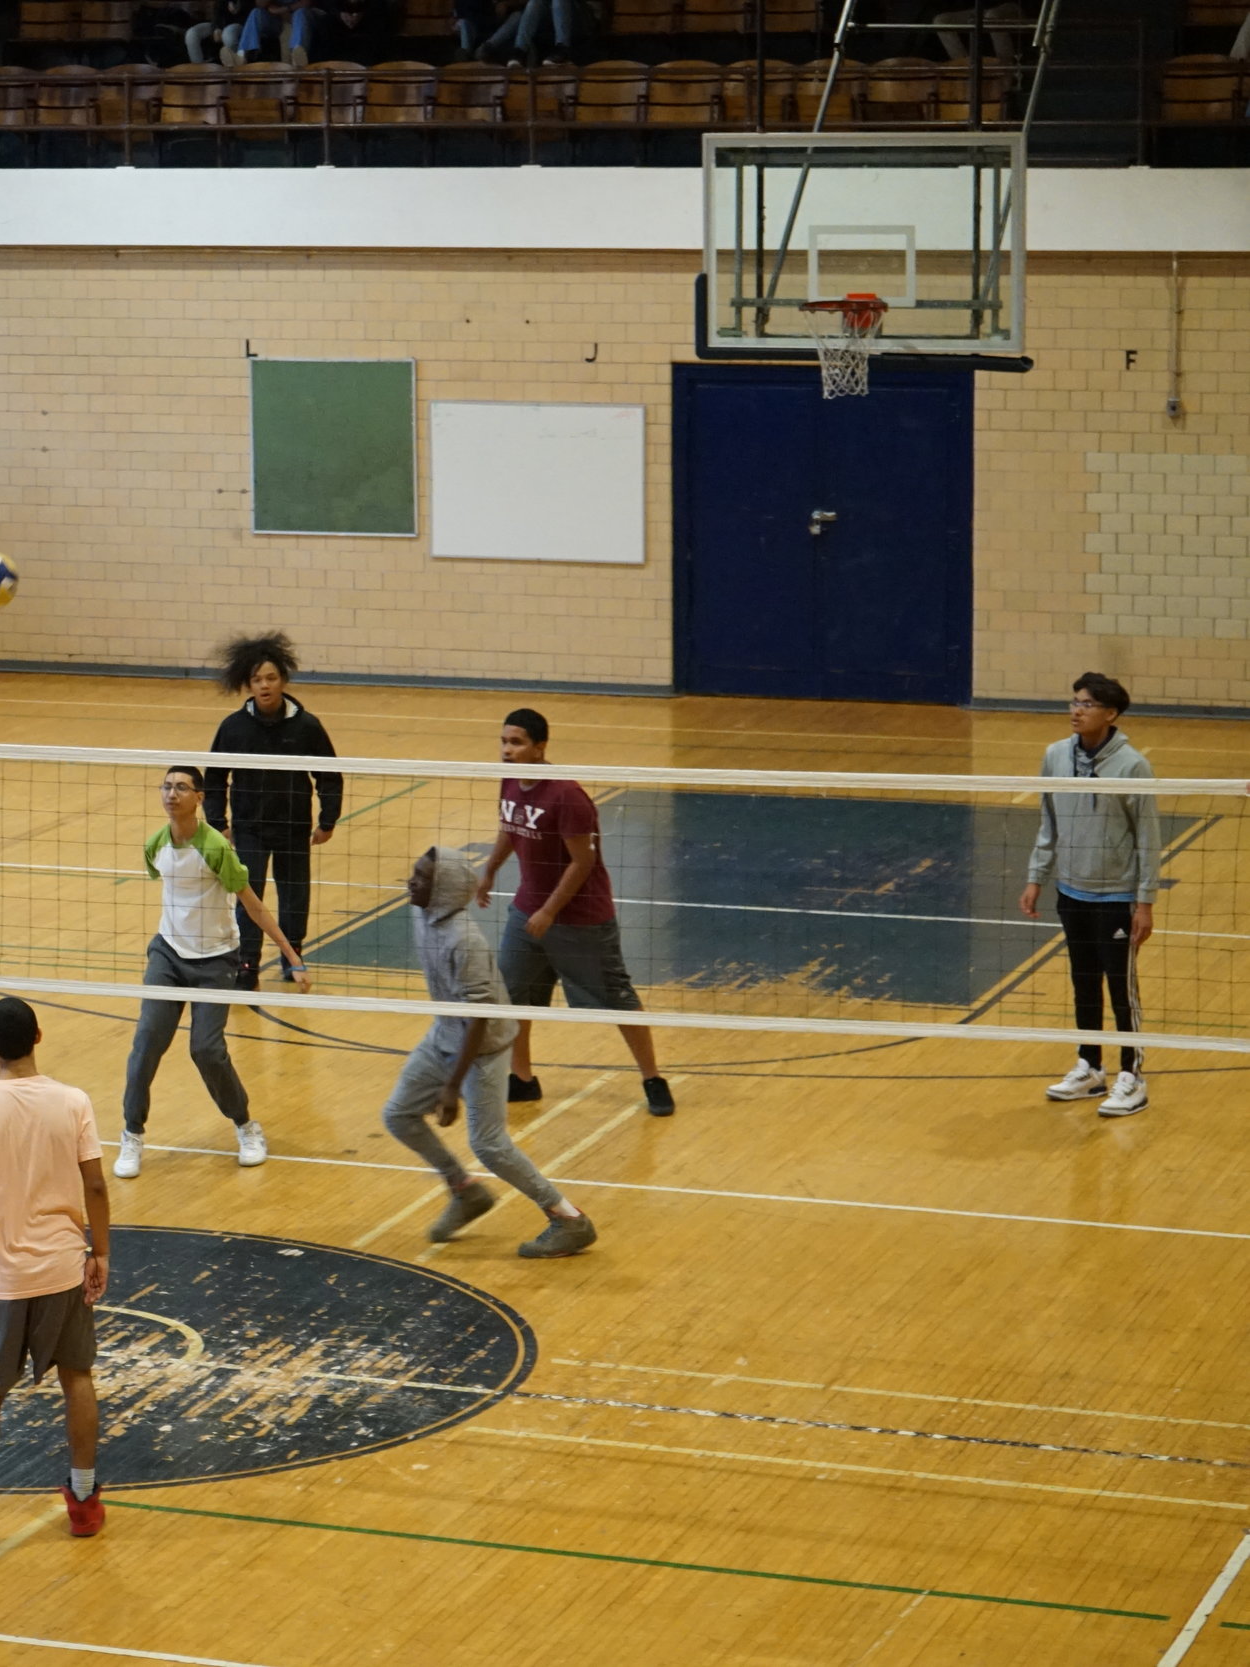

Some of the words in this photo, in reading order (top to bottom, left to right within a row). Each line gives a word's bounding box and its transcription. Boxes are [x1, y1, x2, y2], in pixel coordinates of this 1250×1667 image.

[245, 338, 259, 358] L
[584, 341, 598, 364] J
[1125, 349, 1138, 371] F
